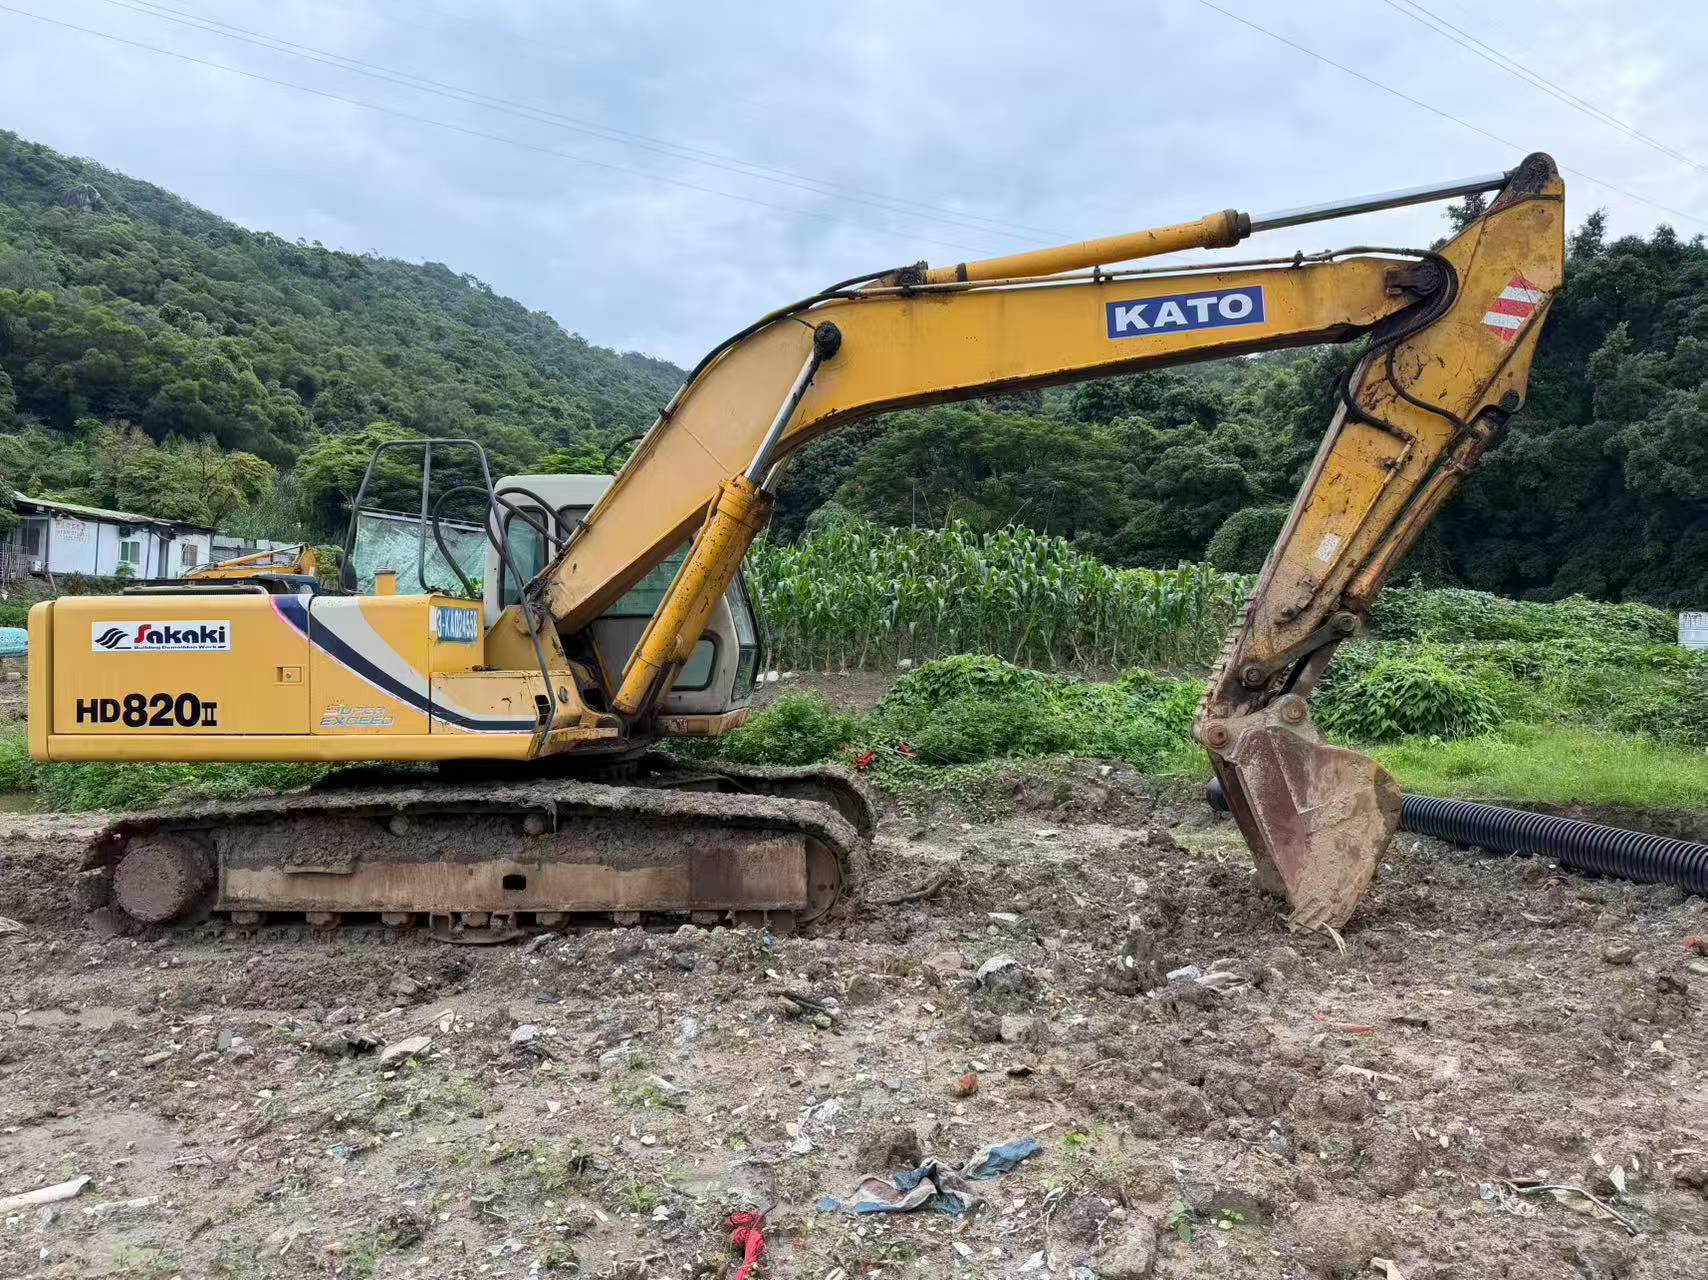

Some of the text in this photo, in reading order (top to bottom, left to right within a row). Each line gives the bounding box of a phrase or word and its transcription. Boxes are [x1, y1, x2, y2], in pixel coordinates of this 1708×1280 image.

[1115, 293, 1253, 332] KATO
[134, 624, 226, 644] Sakaki
[323, 704, 386, 716] SUPER
[320, 716, 395, 726] EXCEED
